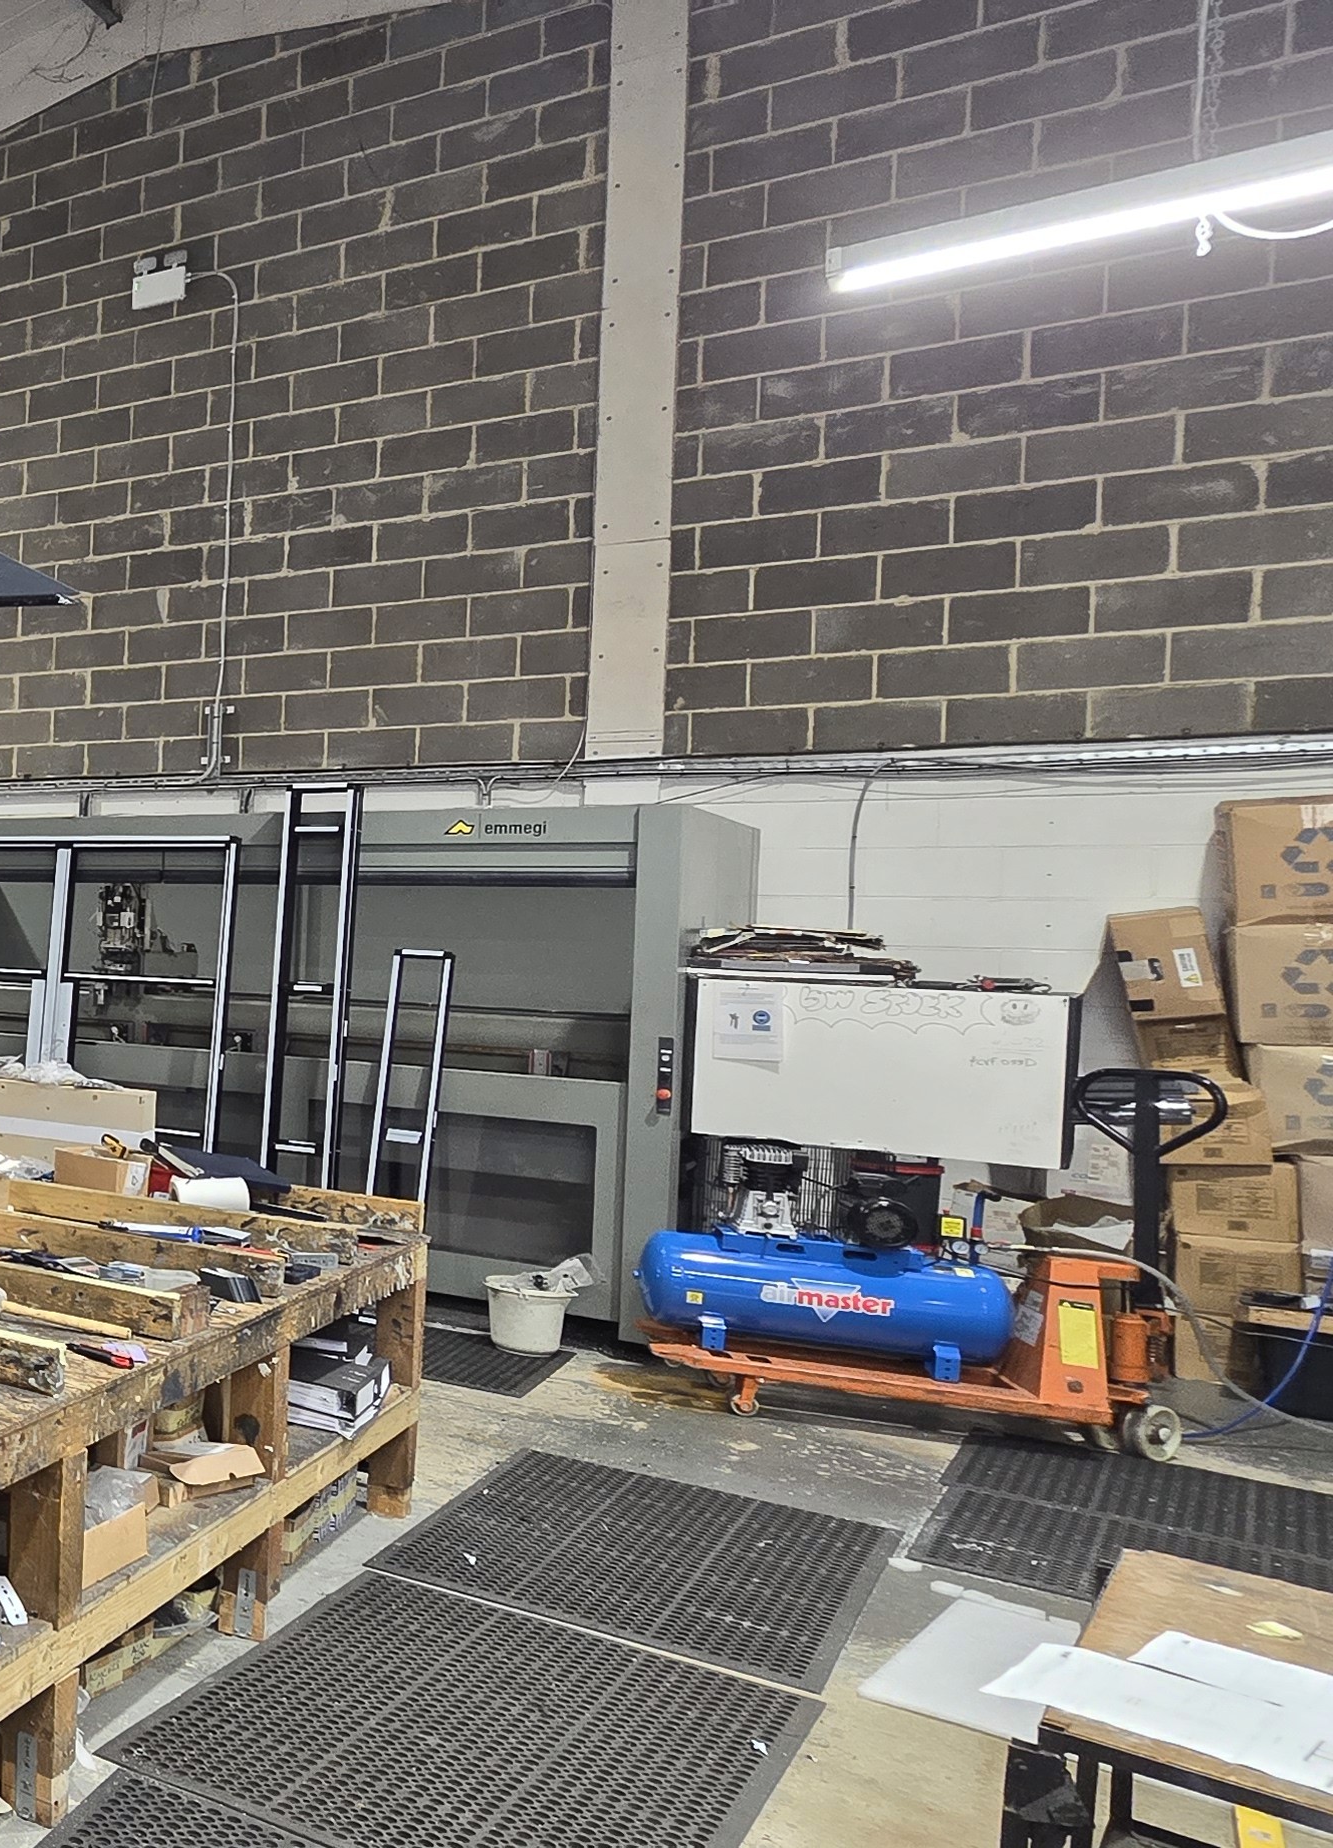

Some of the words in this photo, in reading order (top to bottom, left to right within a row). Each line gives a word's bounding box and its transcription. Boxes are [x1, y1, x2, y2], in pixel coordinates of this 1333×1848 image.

[484, 820, 547, 837] emmegi
[860, 989, 966, 1019] STOCK
[760, 1281, 895, 1317] airmaster
